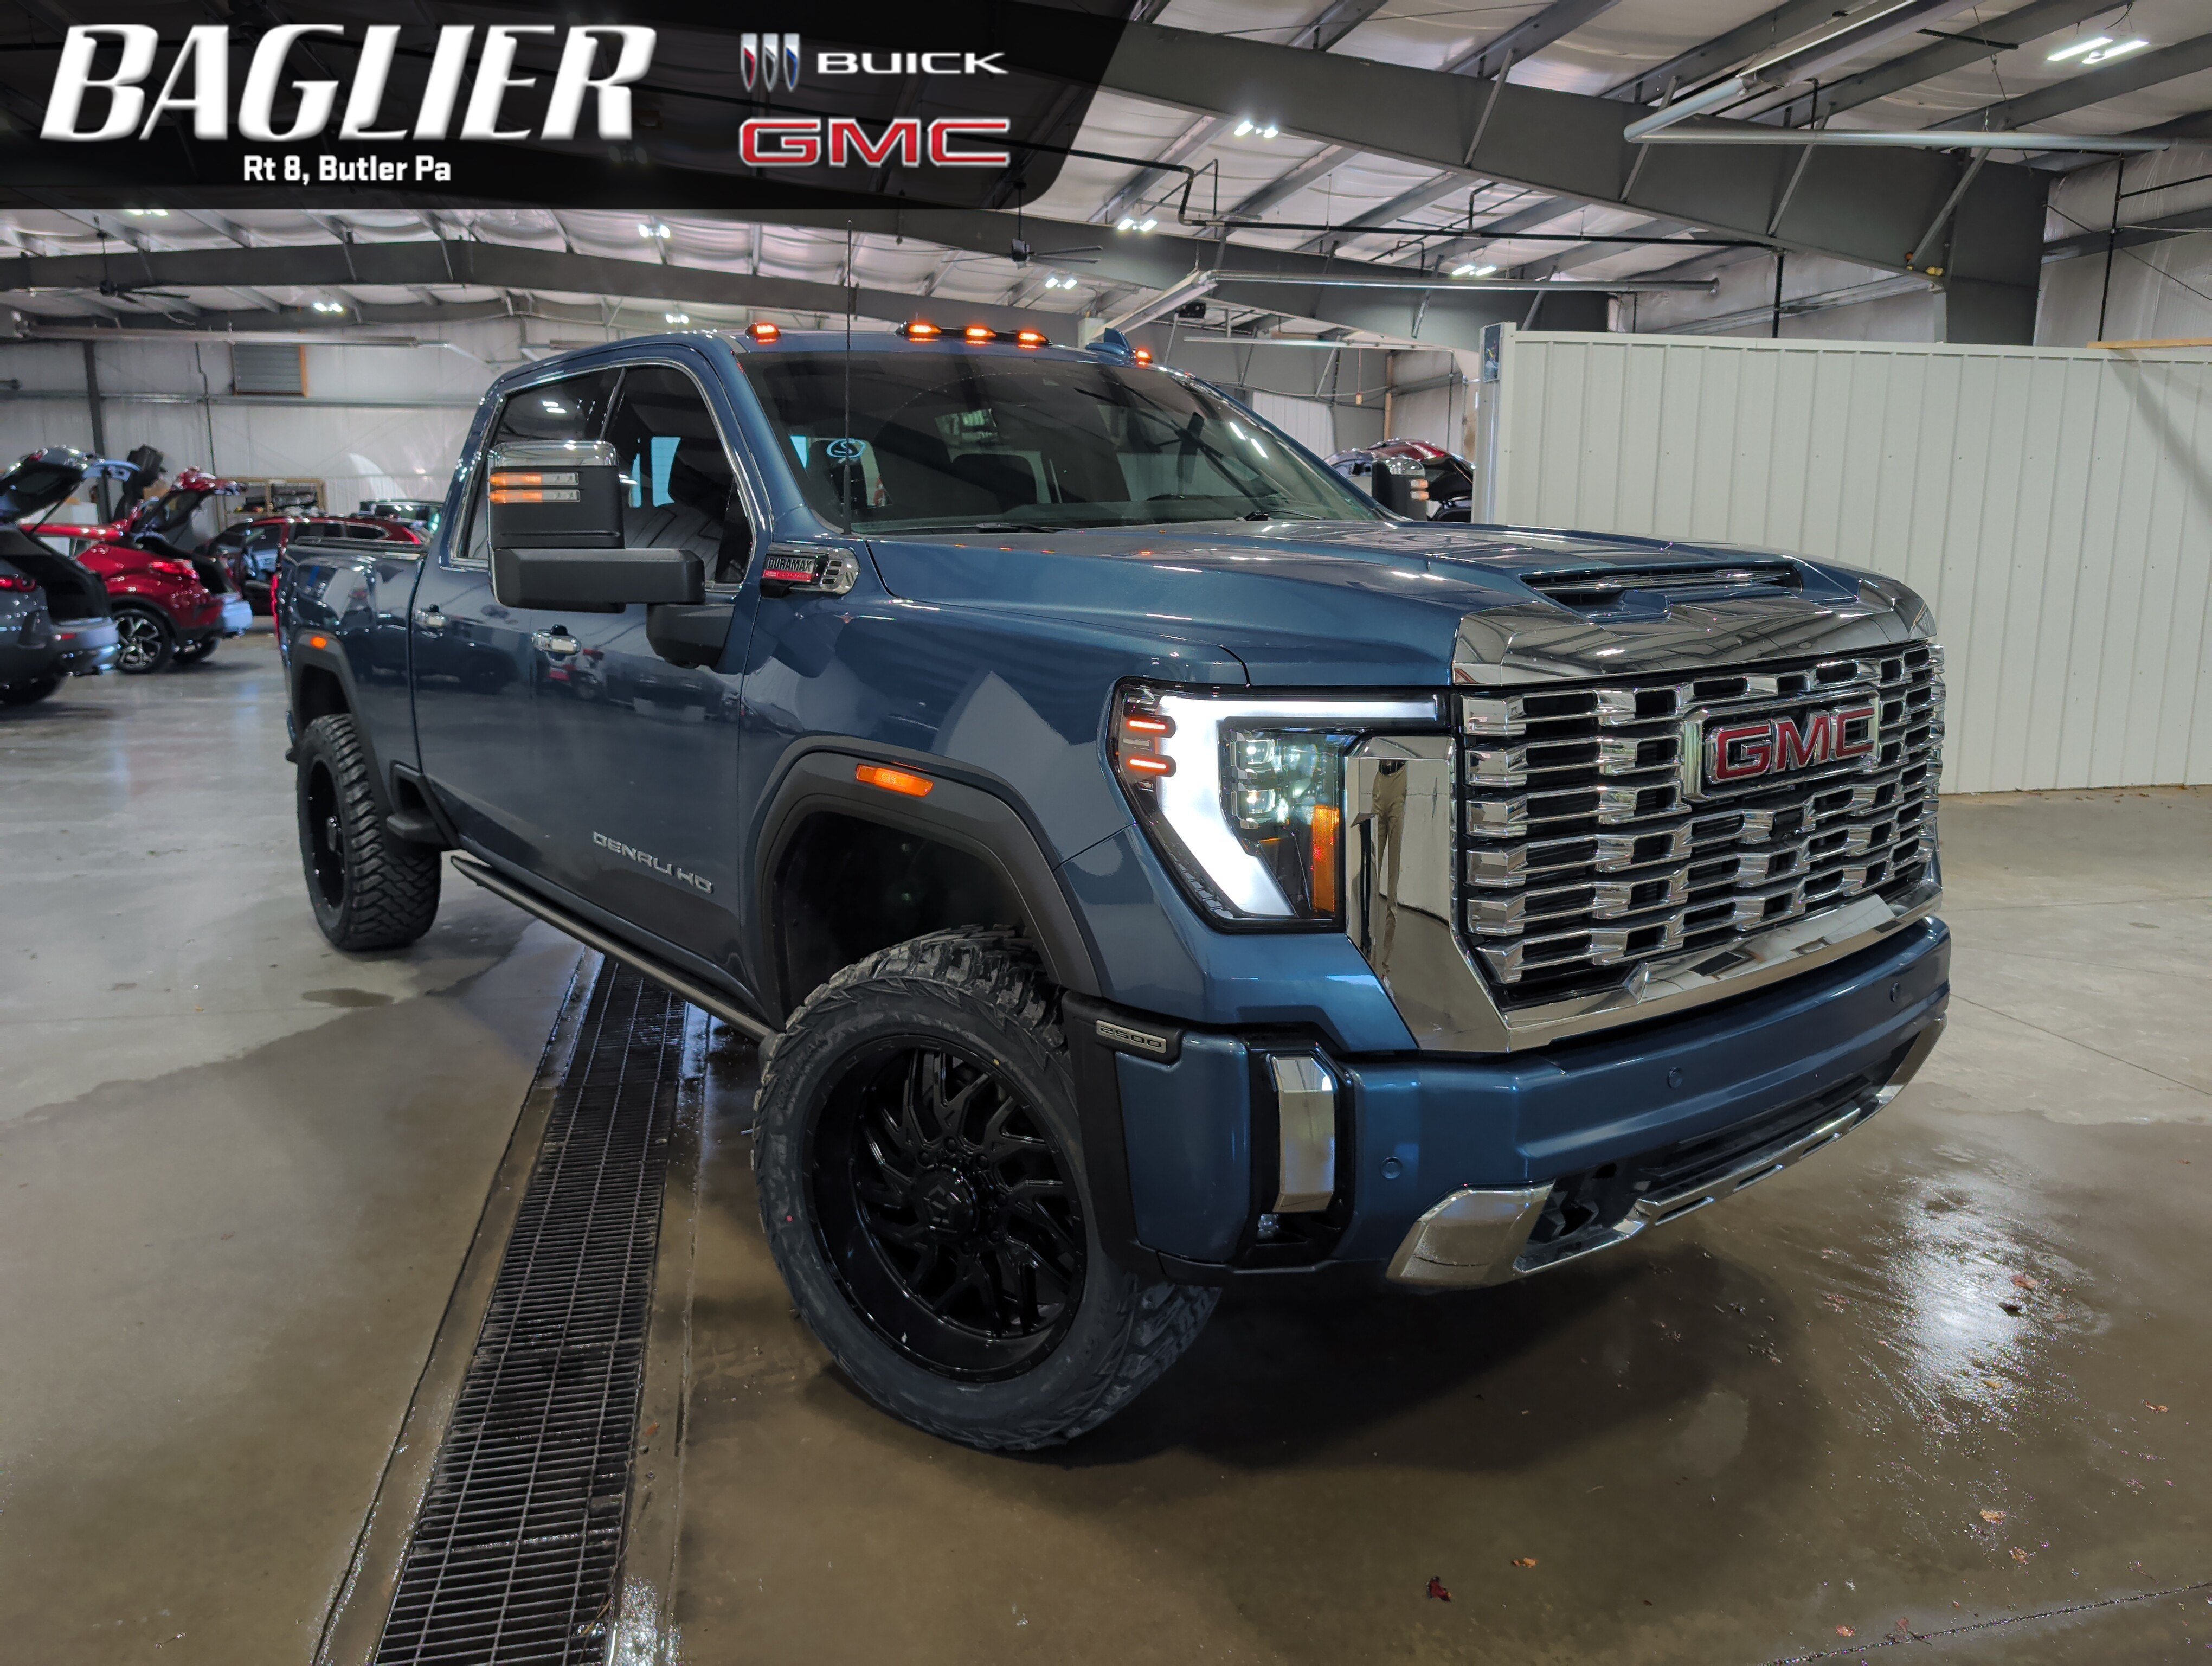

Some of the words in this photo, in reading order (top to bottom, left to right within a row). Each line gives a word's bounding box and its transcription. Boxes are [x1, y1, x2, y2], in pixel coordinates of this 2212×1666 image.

[767, 558, 813, 573] DURAMAX
[1708, 706, 1875, 783] GMC
[593, 831, 674, 876] DENALI
[677, 867, 714, 894] HD
[1099, 1025, 1162, 1048] 2500
